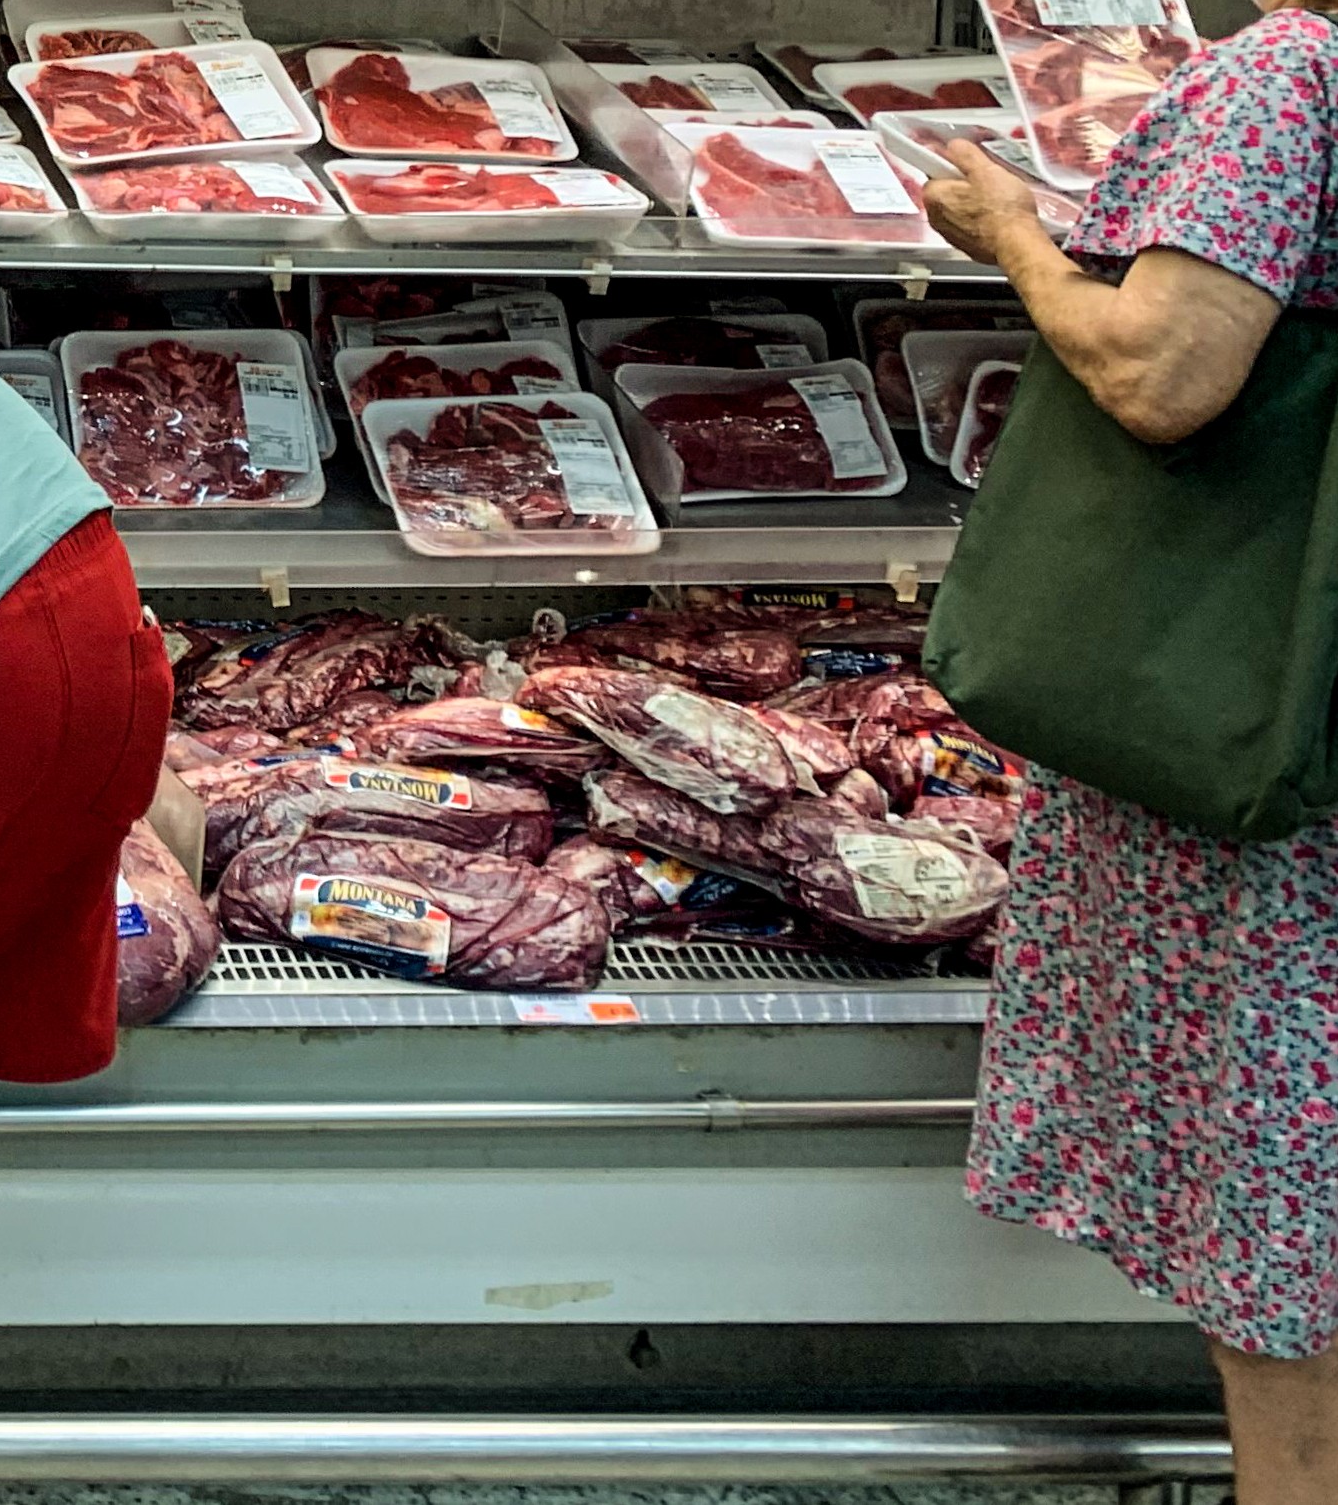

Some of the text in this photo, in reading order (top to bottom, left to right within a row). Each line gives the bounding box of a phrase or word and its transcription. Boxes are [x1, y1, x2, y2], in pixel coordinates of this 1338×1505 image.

[752, 593, 827, 609] MONTANA
[356, 774, 440, 805] MONTANA
[328, 879, 418, 914] MONTANA
